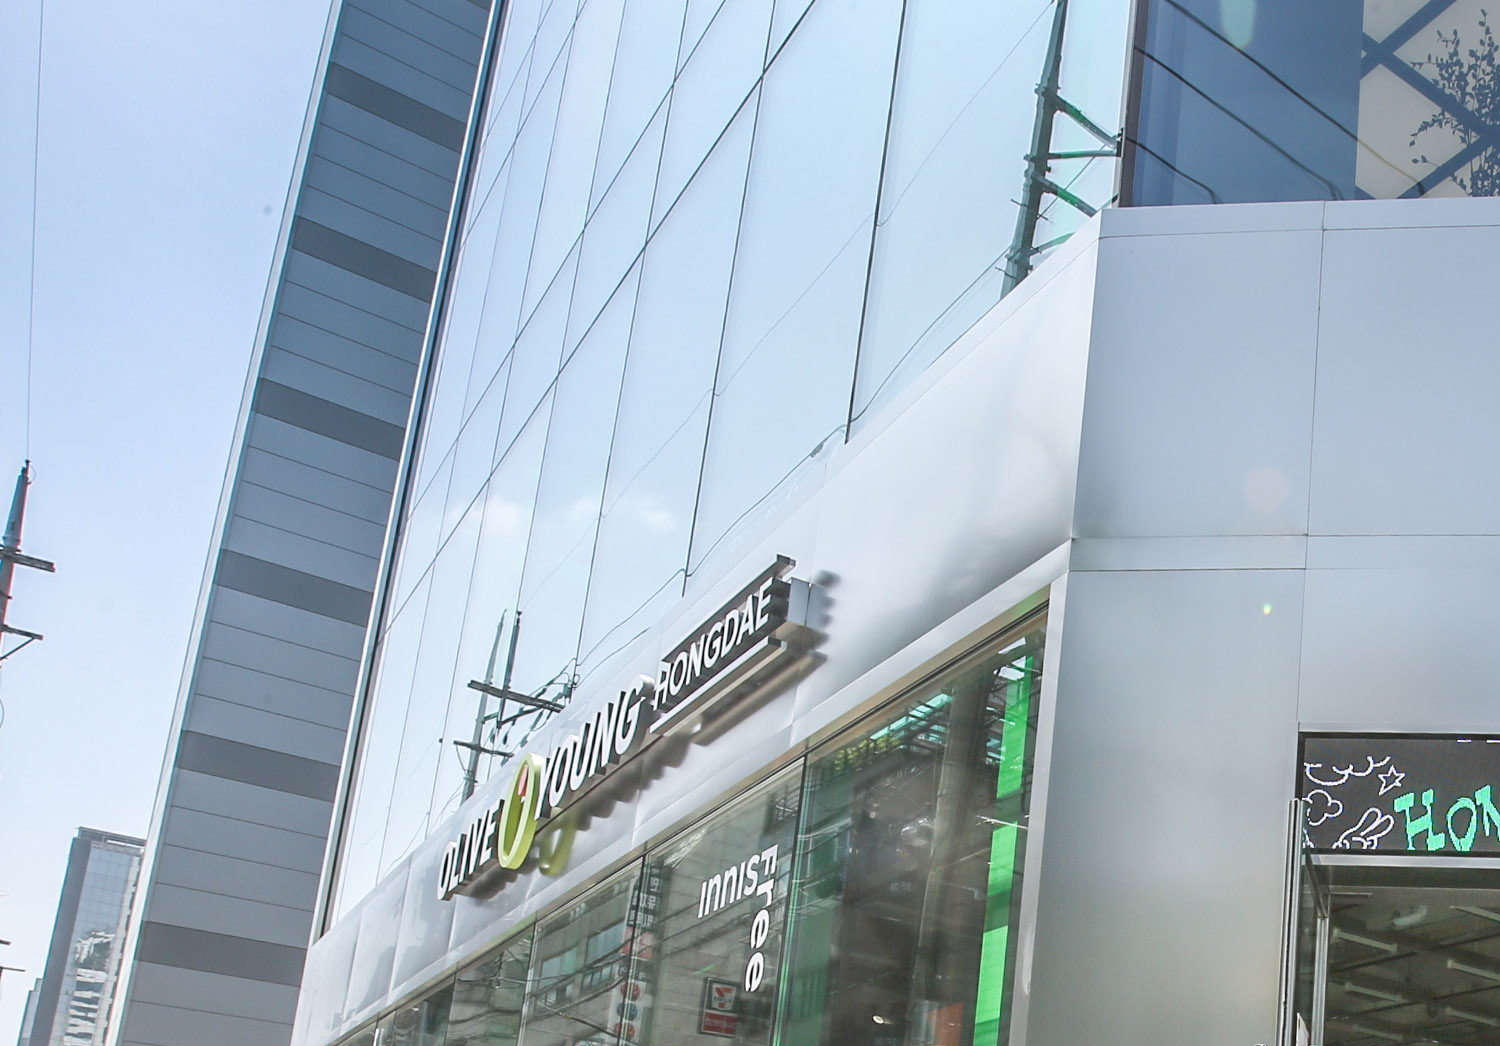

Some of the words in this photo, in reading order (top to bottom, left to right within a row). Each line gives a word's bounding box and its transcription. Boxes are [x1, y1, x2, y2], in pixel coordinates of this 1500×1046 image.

[653, 577, 774, 711] HONGDAE
[437, 799, 505, 901] OLIVE
[534, 675, 650, 821] YOUNG
